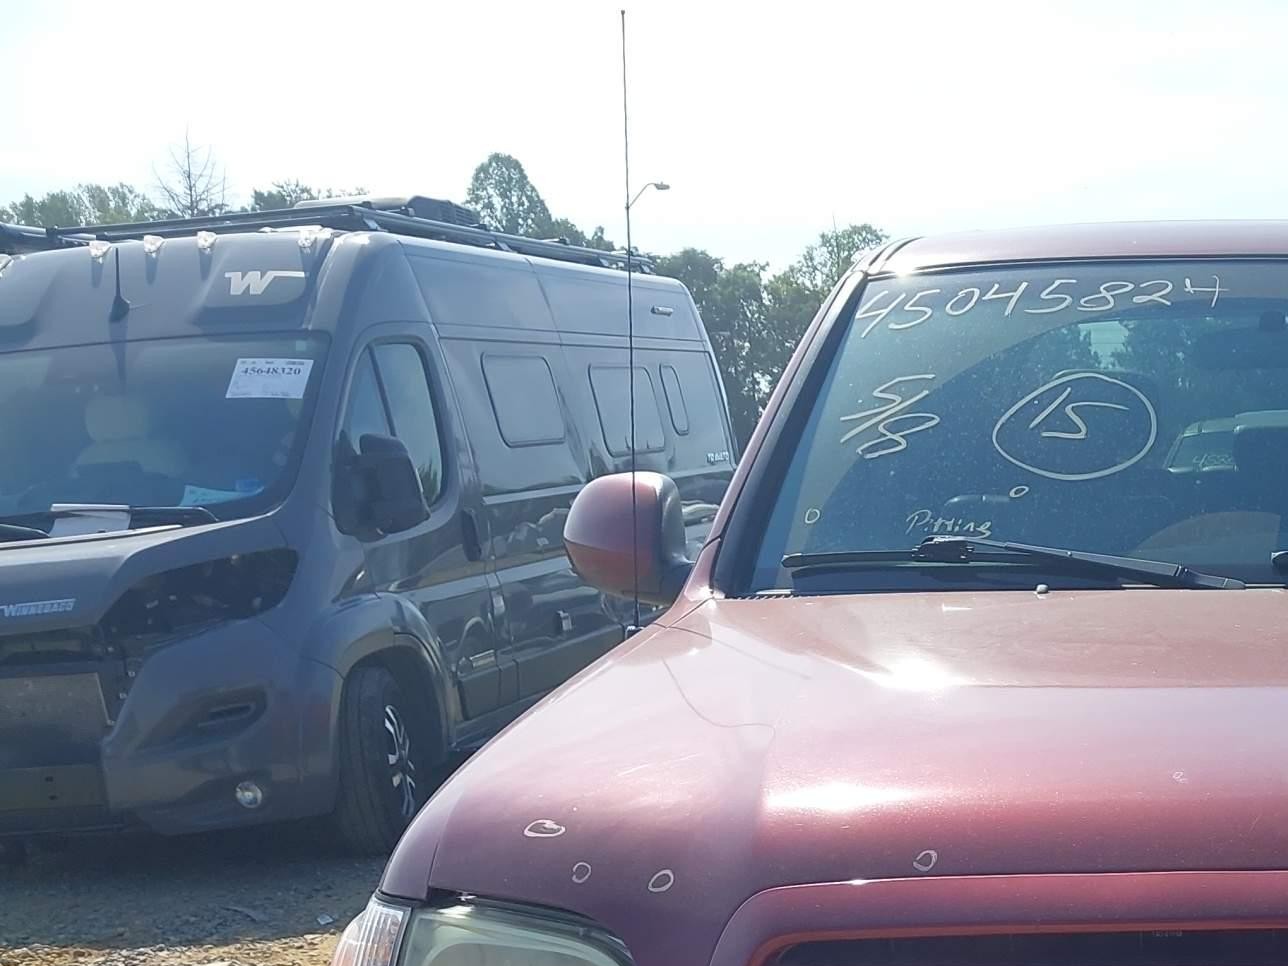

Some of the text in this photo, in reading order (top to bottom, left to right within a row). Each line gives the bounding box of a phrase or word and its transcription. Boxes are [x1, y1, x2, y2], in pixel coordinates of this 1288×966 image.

[856, 275, 1229, 338] 45045824
[241, 367, 302, 376] 45648320
[1029, 387, 1130, 439] 15
